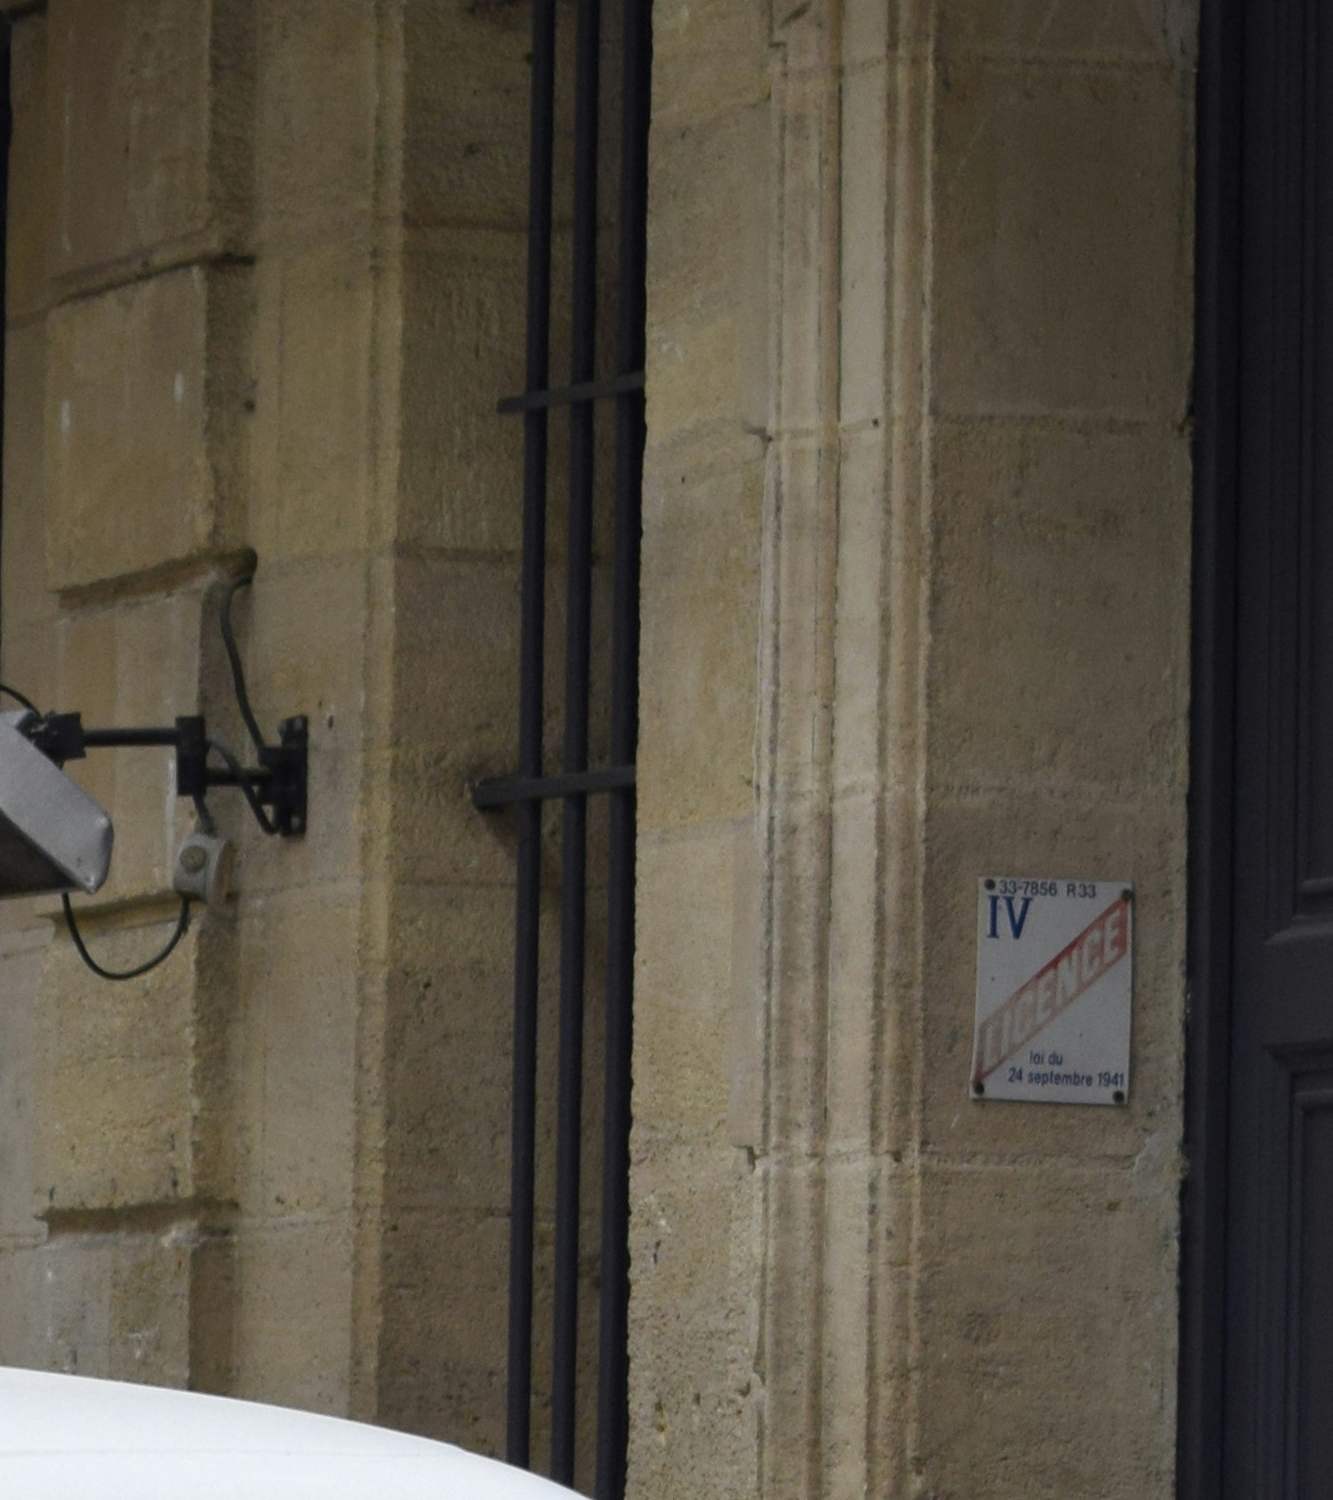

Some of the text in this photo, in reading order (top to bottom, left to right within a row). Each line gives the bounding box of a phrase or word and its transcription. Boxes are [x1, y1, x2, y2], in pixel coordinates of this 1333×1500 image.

[986, 894, 1034, 940] IV
[1029, 1051, 1064, 1067] loi du
[1007, 1068, 1125, 1088] 24 septembre 1941
